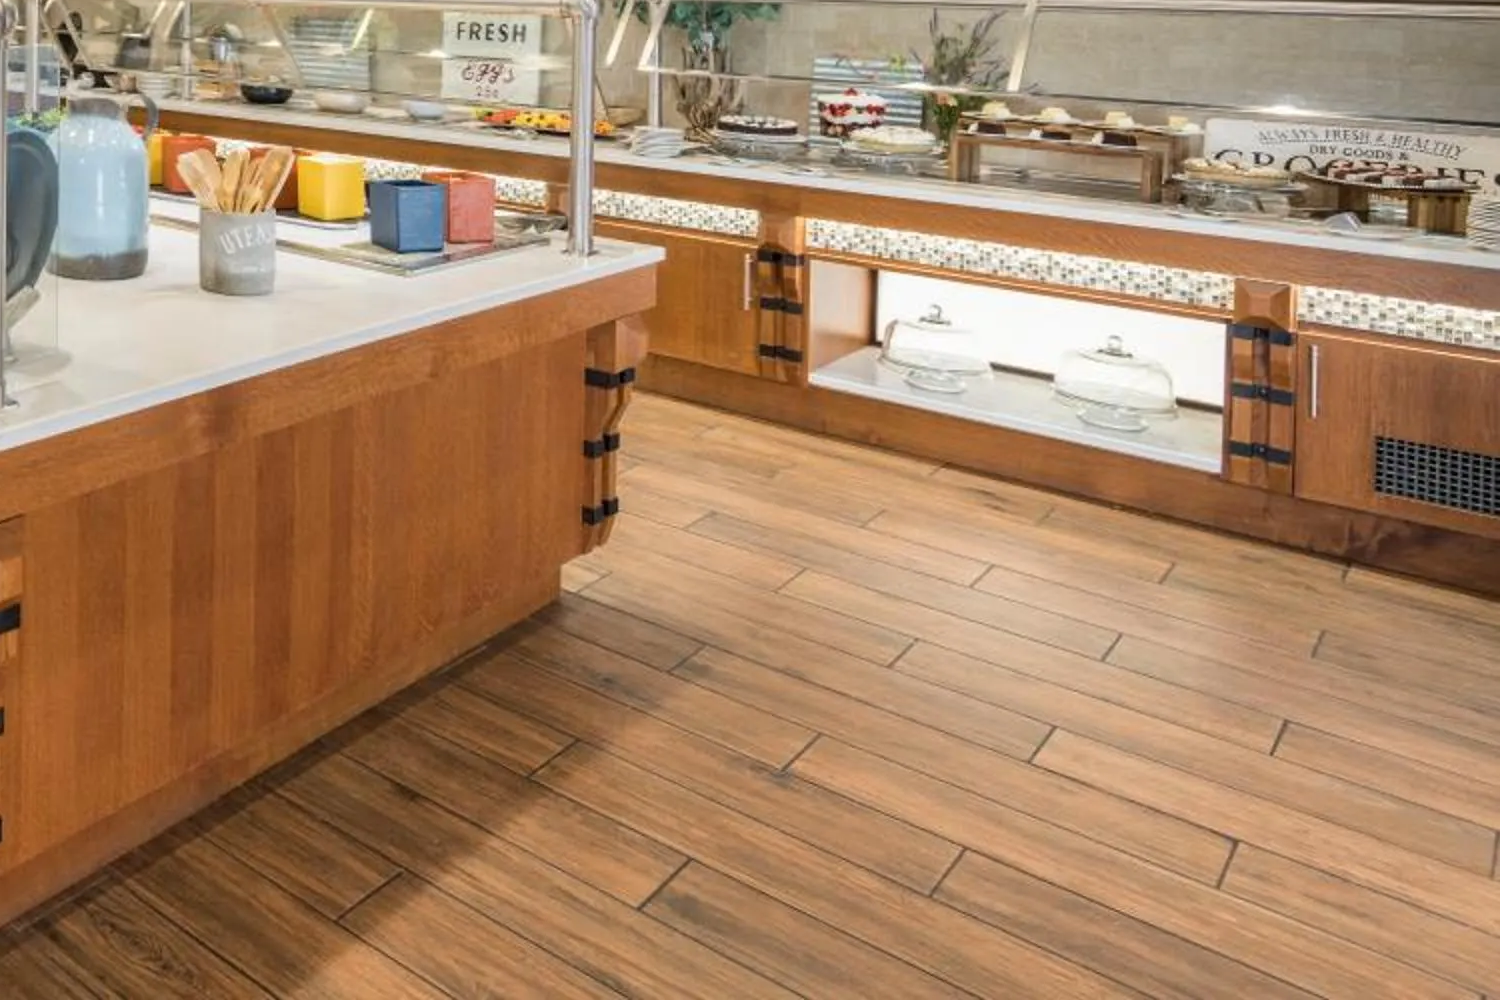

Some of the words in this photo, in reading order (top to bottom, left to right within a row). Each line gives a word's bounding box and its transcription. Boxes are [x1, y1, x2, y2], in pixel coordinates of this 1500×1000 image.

[457, 21, 527, 43] FRESH
[1259, 128, 1319, 140] ALWAYS
[1324, 128, 1371, 141] FRESH
[1392, 133, 1468, 160] HEALTHY
[1309, 144, 1336, 155] DRY
[1342, 147, 1394, 160] GOODS
[1398, 151, 1409, 161] &
